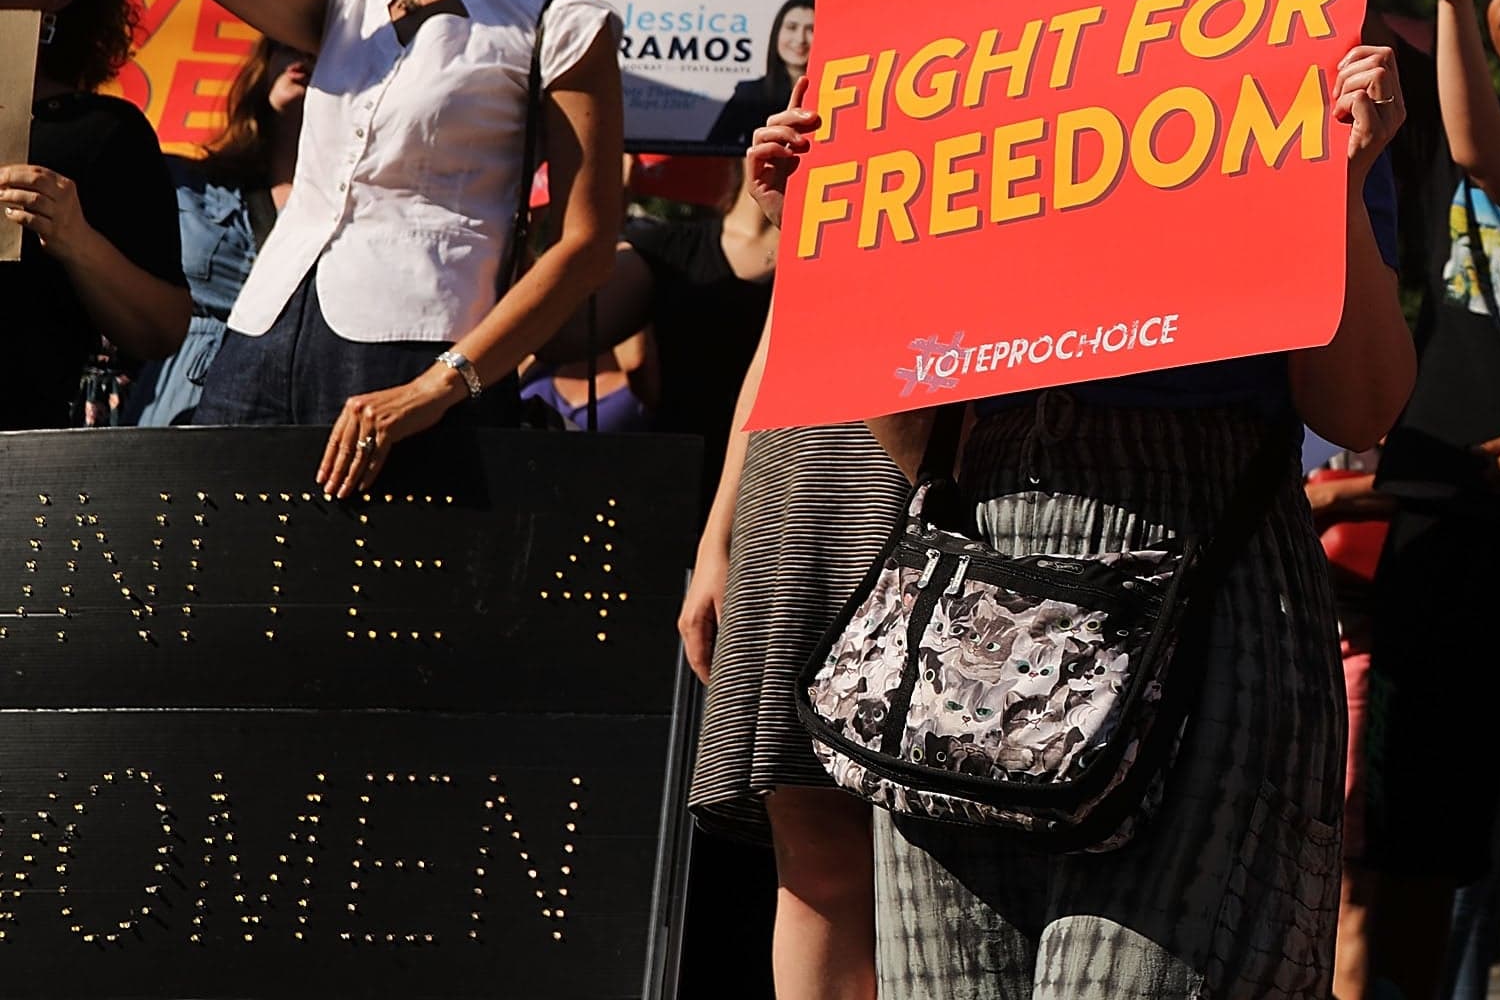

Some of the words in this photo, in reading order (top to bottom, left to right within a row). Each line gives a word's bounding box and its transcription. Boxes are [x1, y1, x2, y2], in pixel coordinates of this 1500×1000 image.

[620, 36, 752, 62] RAMOS
[623, 2, 749, 34] Jessica
[813, 5, 1105, 141] FIGHT
[796, 63, 1333, 261] FREEDOM
[538, 495, 634, 642] 4
